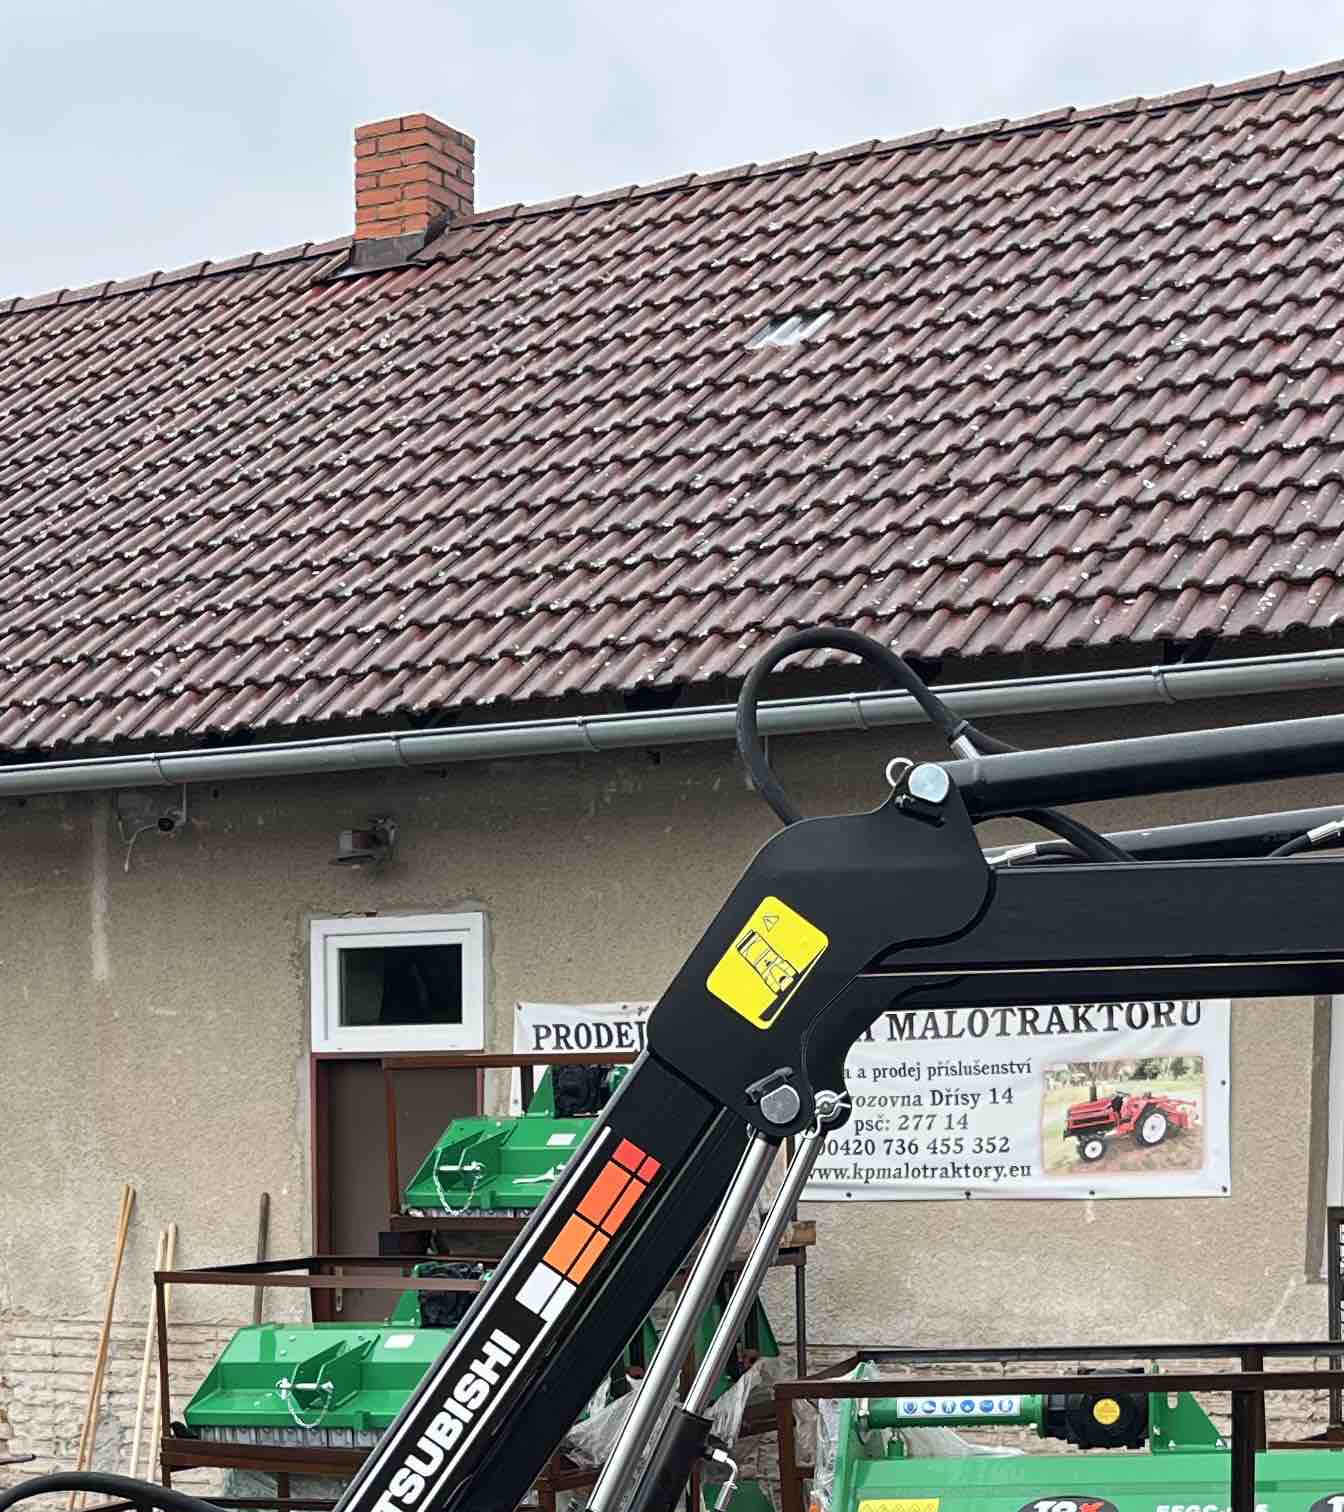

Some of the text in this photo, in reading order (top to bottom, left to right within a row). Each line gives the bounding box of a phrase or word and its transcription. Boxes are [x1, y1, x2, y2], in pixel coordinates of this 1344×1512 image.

[532, 1021, 646, 1051] PRODEJ
[858, 1068, 866, 1079] a
[873, 1062, 921, 1082] prodej
[928, 1057, 1032, 1081] příslušenství
[929, 1088, 981, 1110] Dřísy
[989, 1088, 1013, 1105] 14
[855, 1113, 969, 1136] psč: 277 14
[884, 1138, 919, 1155] 736
[926, 1138, 965, 1155] 455
[972, 1137, 1011, 1154] 352
